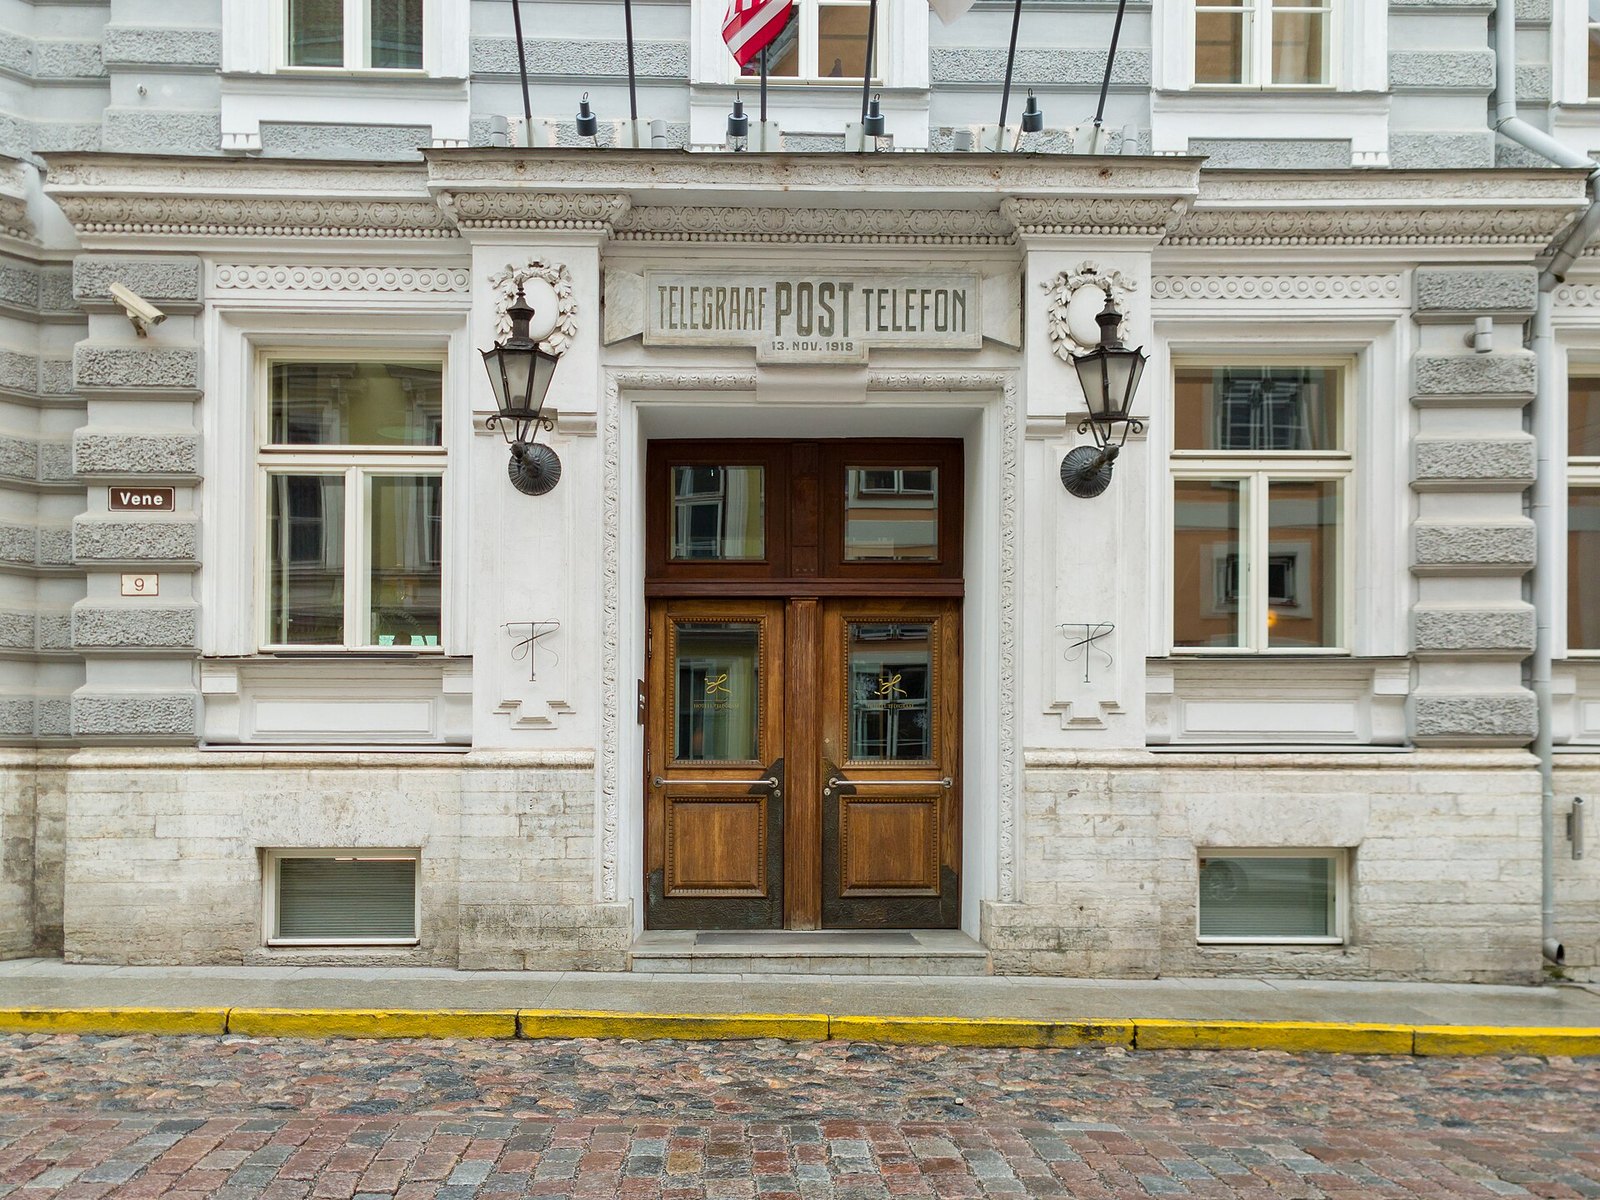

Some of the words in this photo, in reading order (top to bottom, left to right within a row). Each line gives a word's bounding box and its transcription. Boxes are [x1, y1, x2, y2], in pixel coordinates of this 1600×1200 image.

[658, 286, 767, 330] TELEGRAAF
[775, 282, 854, 338] POST
[862, 288, 966, 332] TELEFON
[120, 492, 163, 505] Vene
[134, 578, 144, 591] 9
